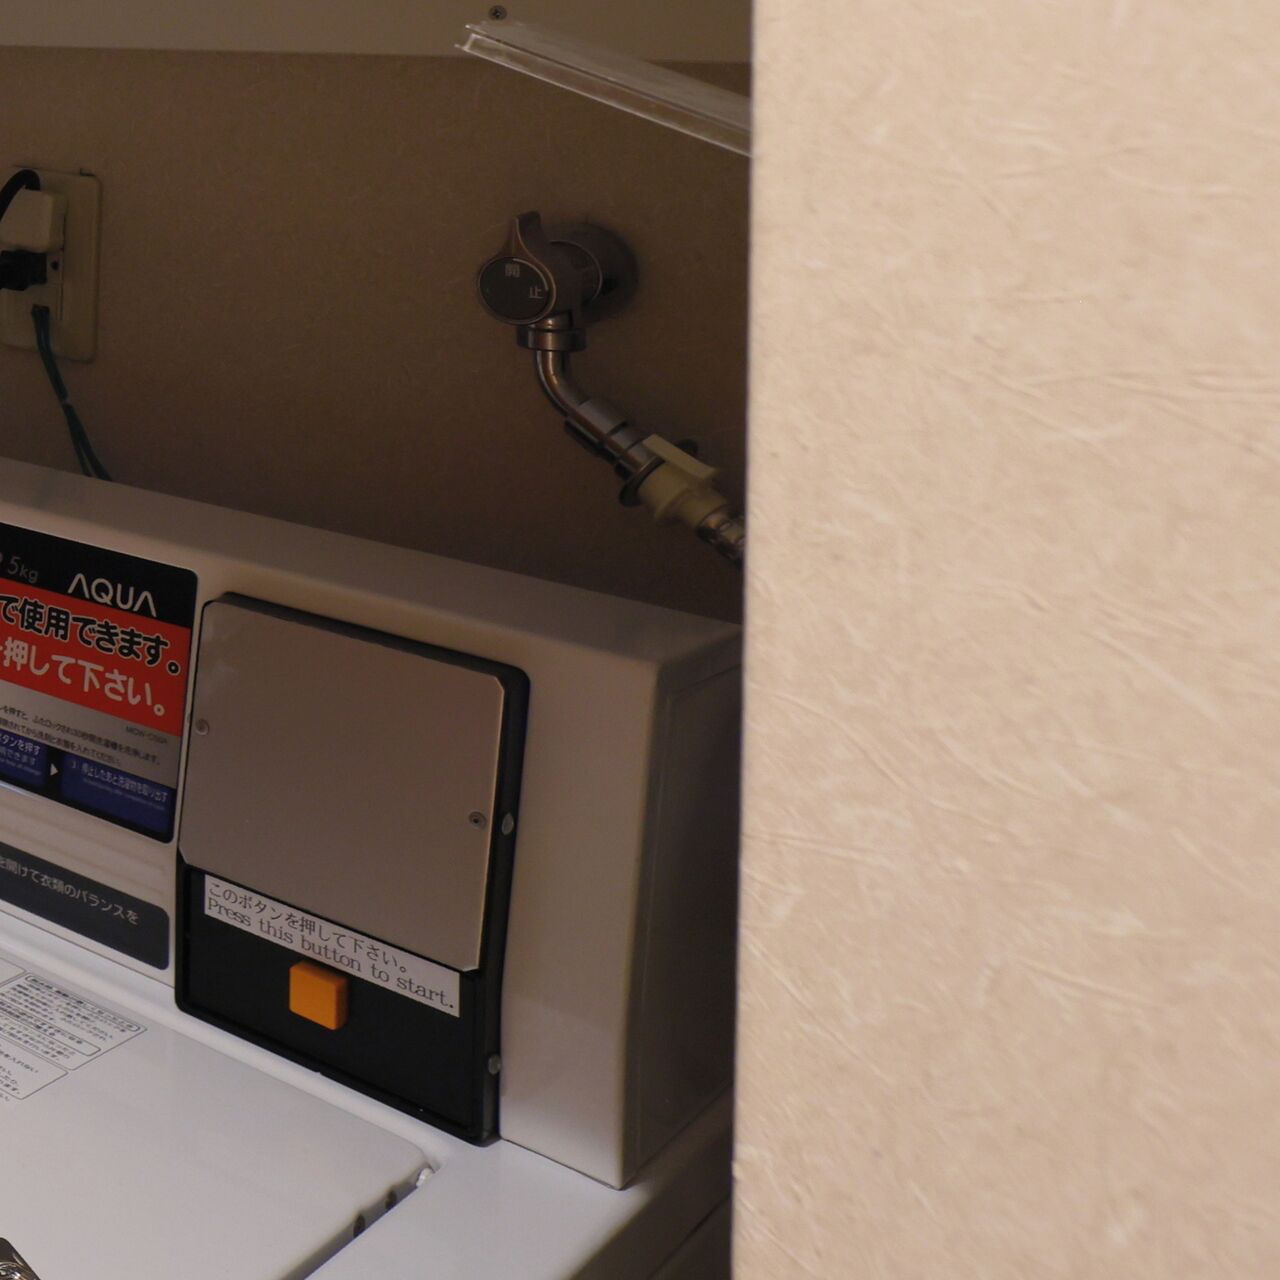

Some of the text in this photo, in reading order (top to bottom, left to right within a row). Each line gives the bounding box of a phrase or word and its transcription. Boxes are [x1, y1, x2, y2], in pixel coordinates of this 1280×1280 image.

[67, 573, 156, 617] AQUA
[208, 898, 455, 1009] Press this button to start.
[209, 882, 406, 974] このボタンを押して下さい。
